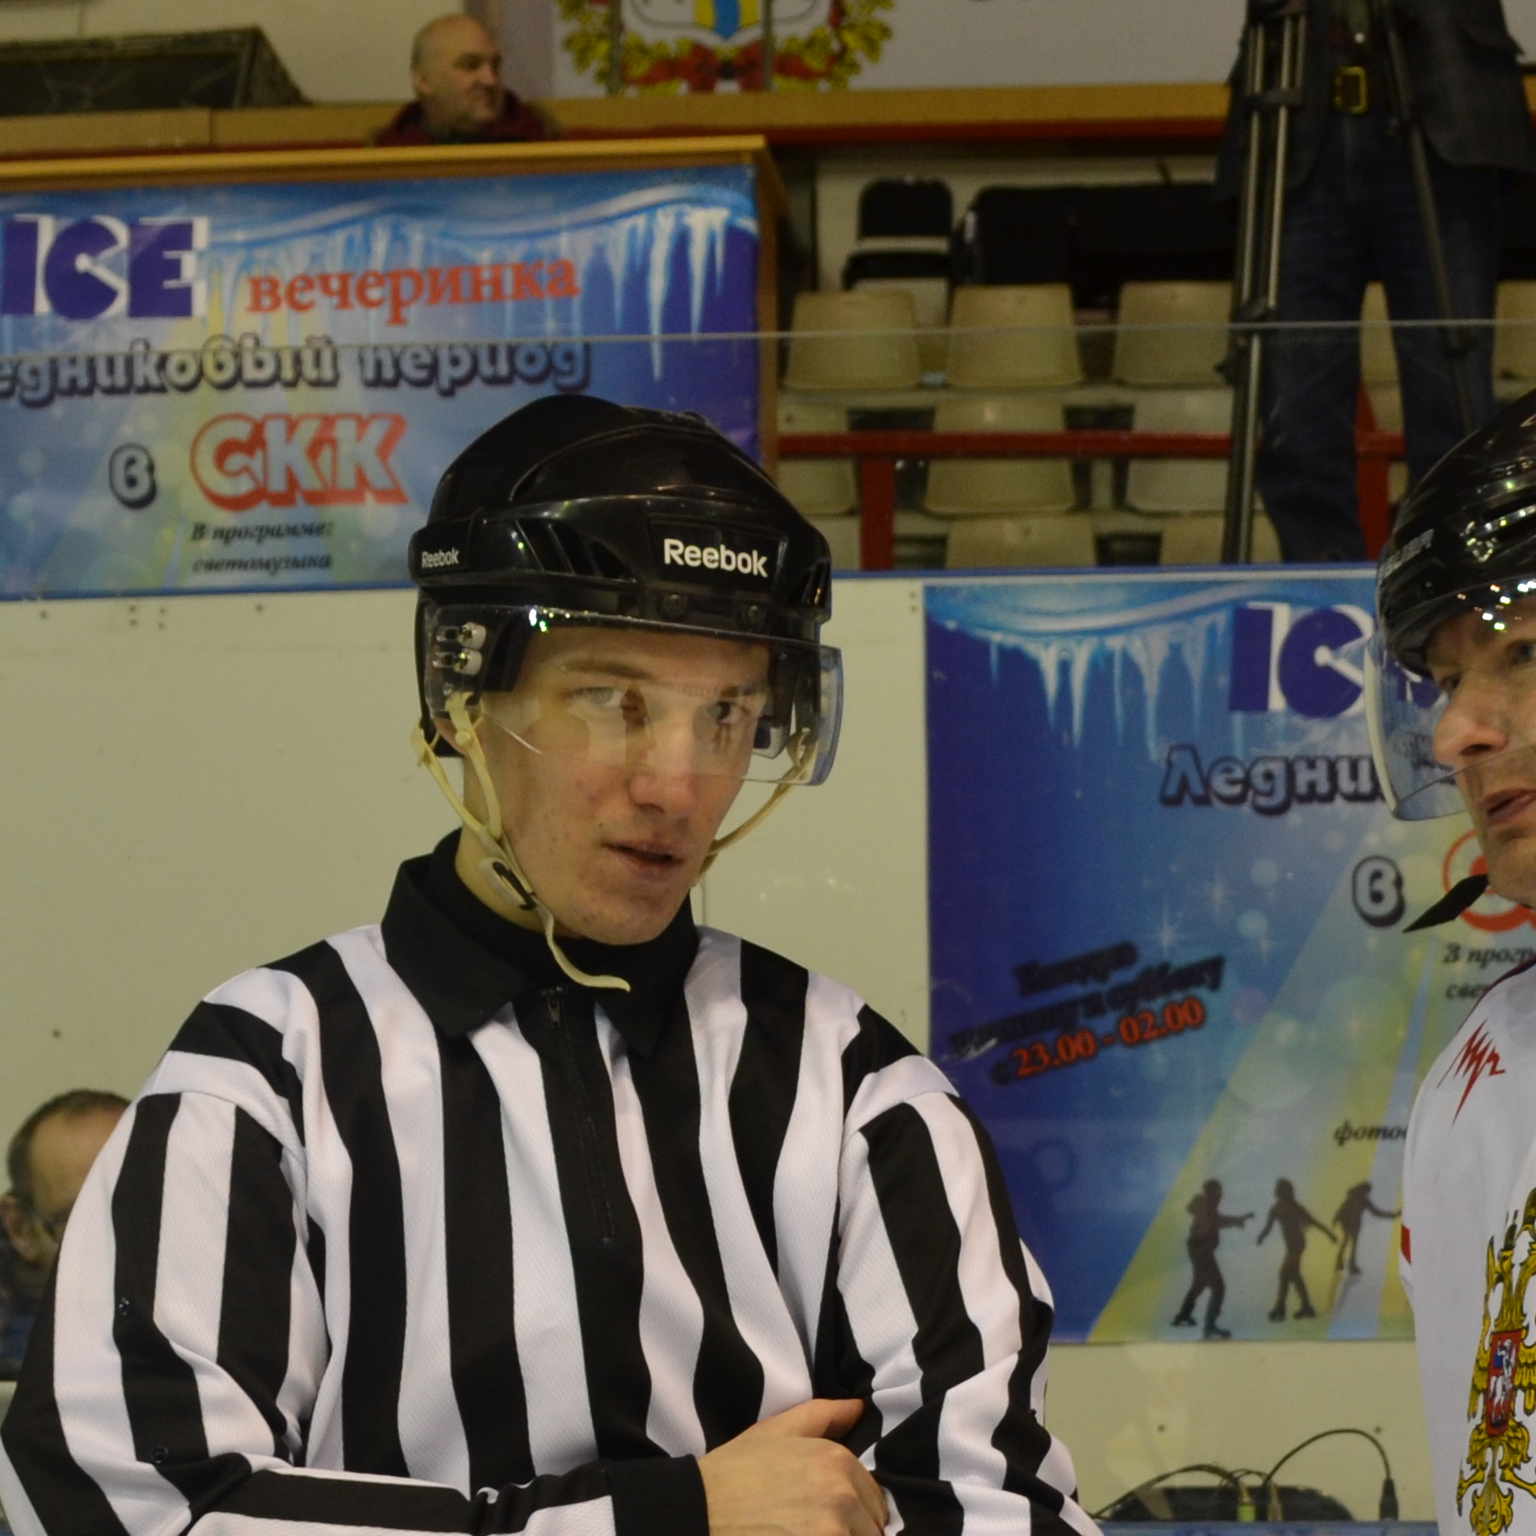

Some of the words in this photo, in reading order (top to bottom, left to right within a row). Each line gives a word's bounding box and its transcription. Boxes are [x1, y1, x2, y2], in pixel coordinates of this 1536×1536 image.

[0, 214, 208, 320] ICE
[245, 257, 580, 326] вечеринка
[359, 336, 592, 396] период
[190, 413, 408, 511] СКК
[421, 547, 460, 569] Reebok
[663, 536, 768, 579] Reebok
[1014, 1030, 1096, 1079] 23.00
[1118, 997, 1205, 1046] 02.00
